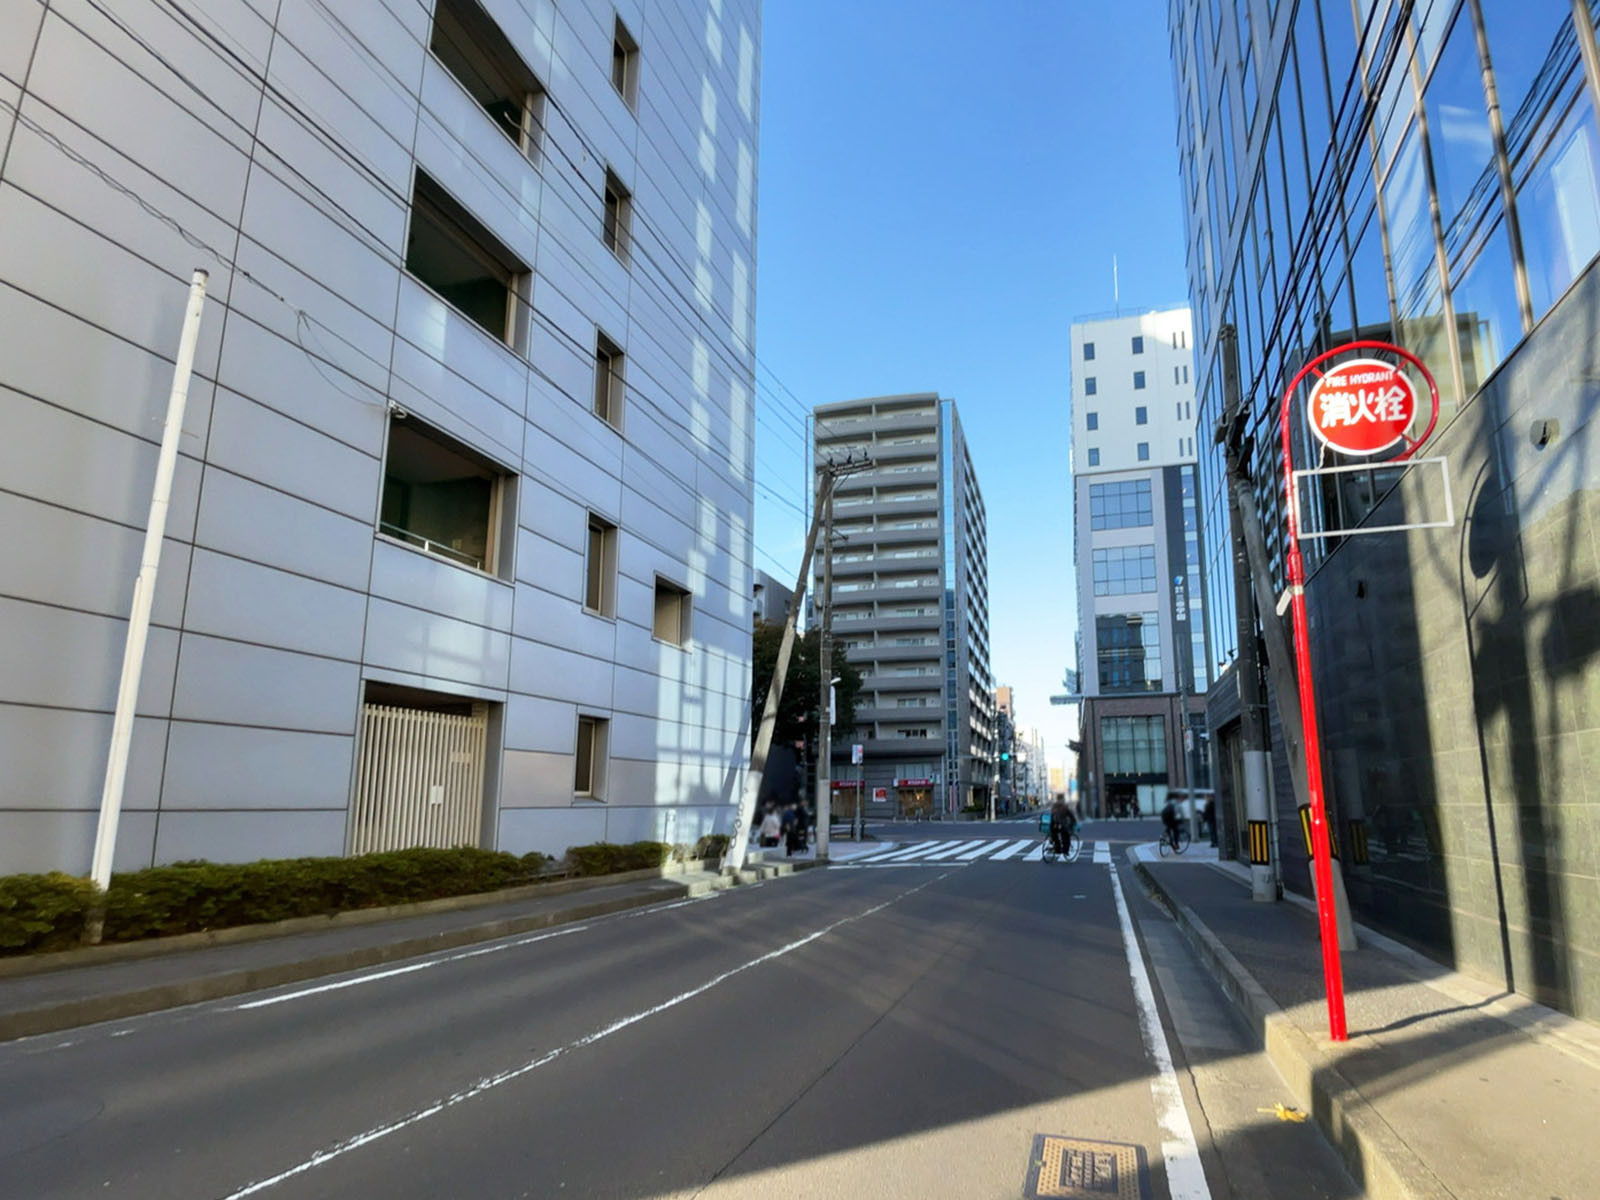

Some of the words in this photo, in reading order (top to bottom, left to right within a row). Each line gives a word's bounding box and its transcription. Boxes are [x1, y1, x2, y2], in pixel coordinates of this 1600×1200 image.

[1325, 375, 1347, 388] FIRE
[1349, 371, 1394, 385] HYDRANT
[1319, 385, 1407, 428] 消火栓
